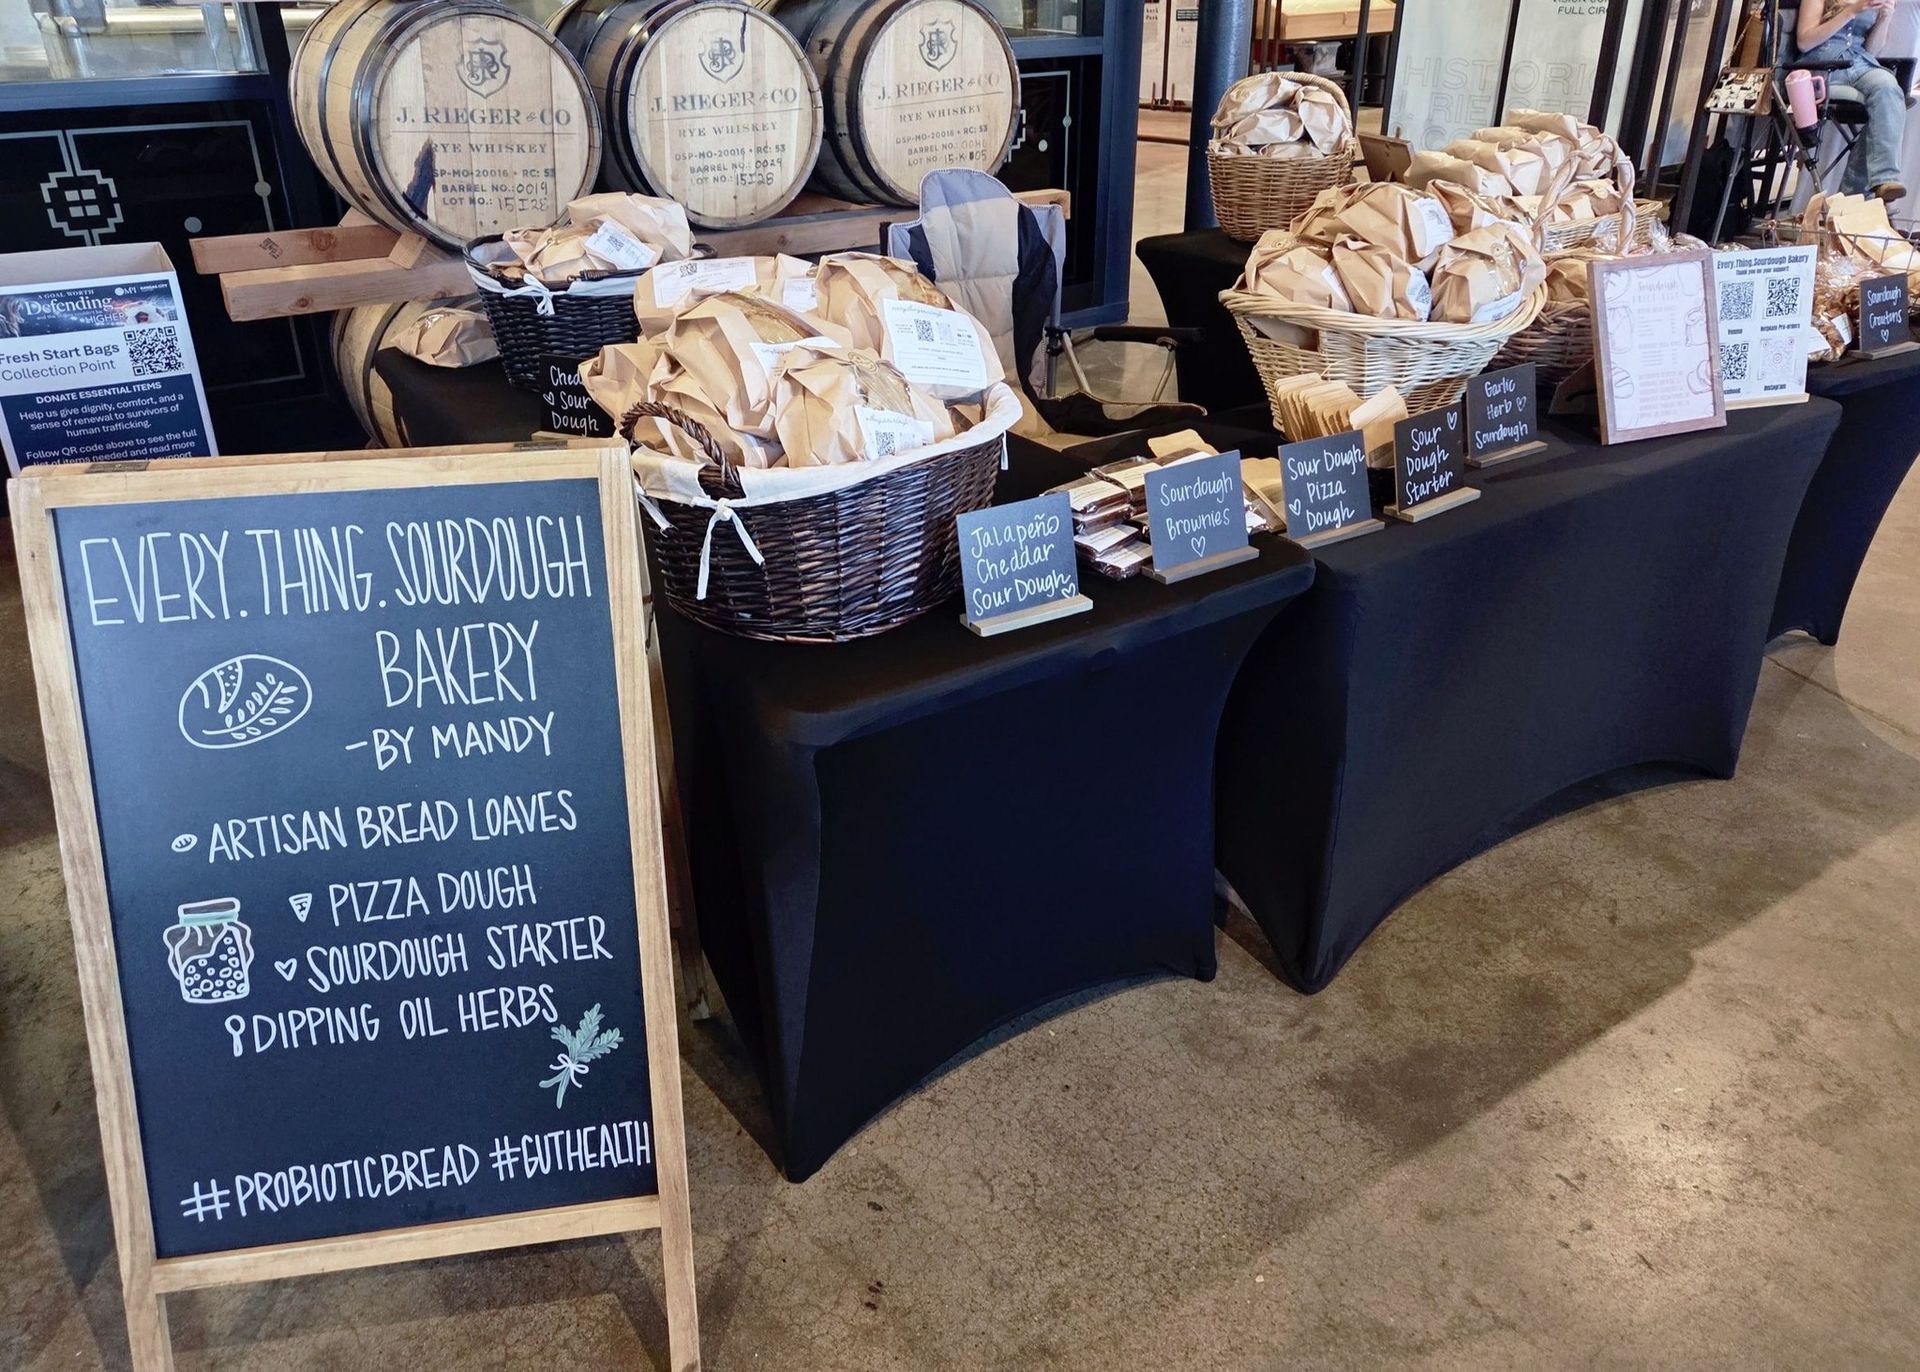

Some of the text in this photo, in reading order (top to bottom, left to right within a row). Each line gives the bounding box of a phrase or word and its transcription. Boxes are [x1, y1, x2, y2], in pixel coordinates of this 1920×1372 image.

[1558, 6, 1585, 15] FULL
[897, 78, 964, 99] RIEGER
[977, 74, 1000, 88] CO
[673, 91, 754, 111] RIEGER
[771, 88, 797, 103] CO
[396, 107, 415, 124] J.
[425, 107, 521, 125] RIEGER
[540, 108, 571, 126] CO
[900, 105, 983, 123] RYE WHISKEY
[679, 121, 777, 137] RYE WHISKEY
[430, 143, 548, 154] RYE WHISKEY
[908, 145, 938, 155] BARREL
[433, 169, 508, 177] SP-MO-20016
[690, 163, 728, 174] BARREL
[442, 184, 487, 192] BARREL
[443, 197, 464, 205] LOT
[1788, 254, 1809, 264] Bakery
[66, 289, 95, 298] WORTH
[1867, 286, 1902, 307] Sourdough
[25, 296, 113, 317] Defending
[1869, 309, 1902, 329] Croutons
[0, 343, 120, 364] Fresh Start Bags
[2, 359, 117, 381] Collection Point
[550, 365, 580, 386] Ched
[36, 382, 162, 404] DONATE ESSENTIAL ITEMS
[1484, 377, 1516, 398] Garlic
[20, 409, 44, 421] Help
[47, 409, 58, 418] us
[60, 407, 80, 419] give
[81, 402, 115, 416] dignity,
[117, 398, 157, 410] comfort,
[159, 394, 175, 404] and
[560, 391, 592, 410] Sour
[1487, 400, 1512, 421] Herb
[30, 403, 180, 431] sense of renewal to survivors of
[66, 418, 152, 438] human trafficking.
[552, 411, 599, 437] Dough
[26, 428, 197, 460] Follow QR code above to see the full
[1411, 426, 1442, 451] Sour
[1475, 421, 1528, 449] Sourdough
[63, 455, 91, 464] items
[92, 451, 128, 463] needed
[130, 448, 147, 458] and
[150, 444, 170, 454] read
[172, 441, 195, 450] more
[1287, 444, 1365, 480] Sour Dough
[1406, 446, 1450, 477] Dough
[1160, 472, 1233, 507] Sourdough
[1307, 477, 1347, 504] Pizza
[1406, 469, 1453, 505] Starter
[1166, 507, 1230, 541] Brownies
[1306, 500, 1355, 531] Dough
[971, 514, 1060, 558] Jalapeño
[976, 542, 1055, 584] Cheddar
[972, 568, 1071, 617] Sour Dough
[376, 620, 540, 708] BAKERY
[432, 711, 555, 759] MANDY
[208, 789, 578, 863] ARTISAN BREAD LOAVES
[329, 864, 537, 926] PIZZA DOUGH
[306, 915, 613, 992] SOURDOUGH STARTER
[252, 984, 560, 1053] DIPPING OIL HERBS
[180, 1119, 652, 1222] #PROBIOTICBREAD #GUTHEALTH
